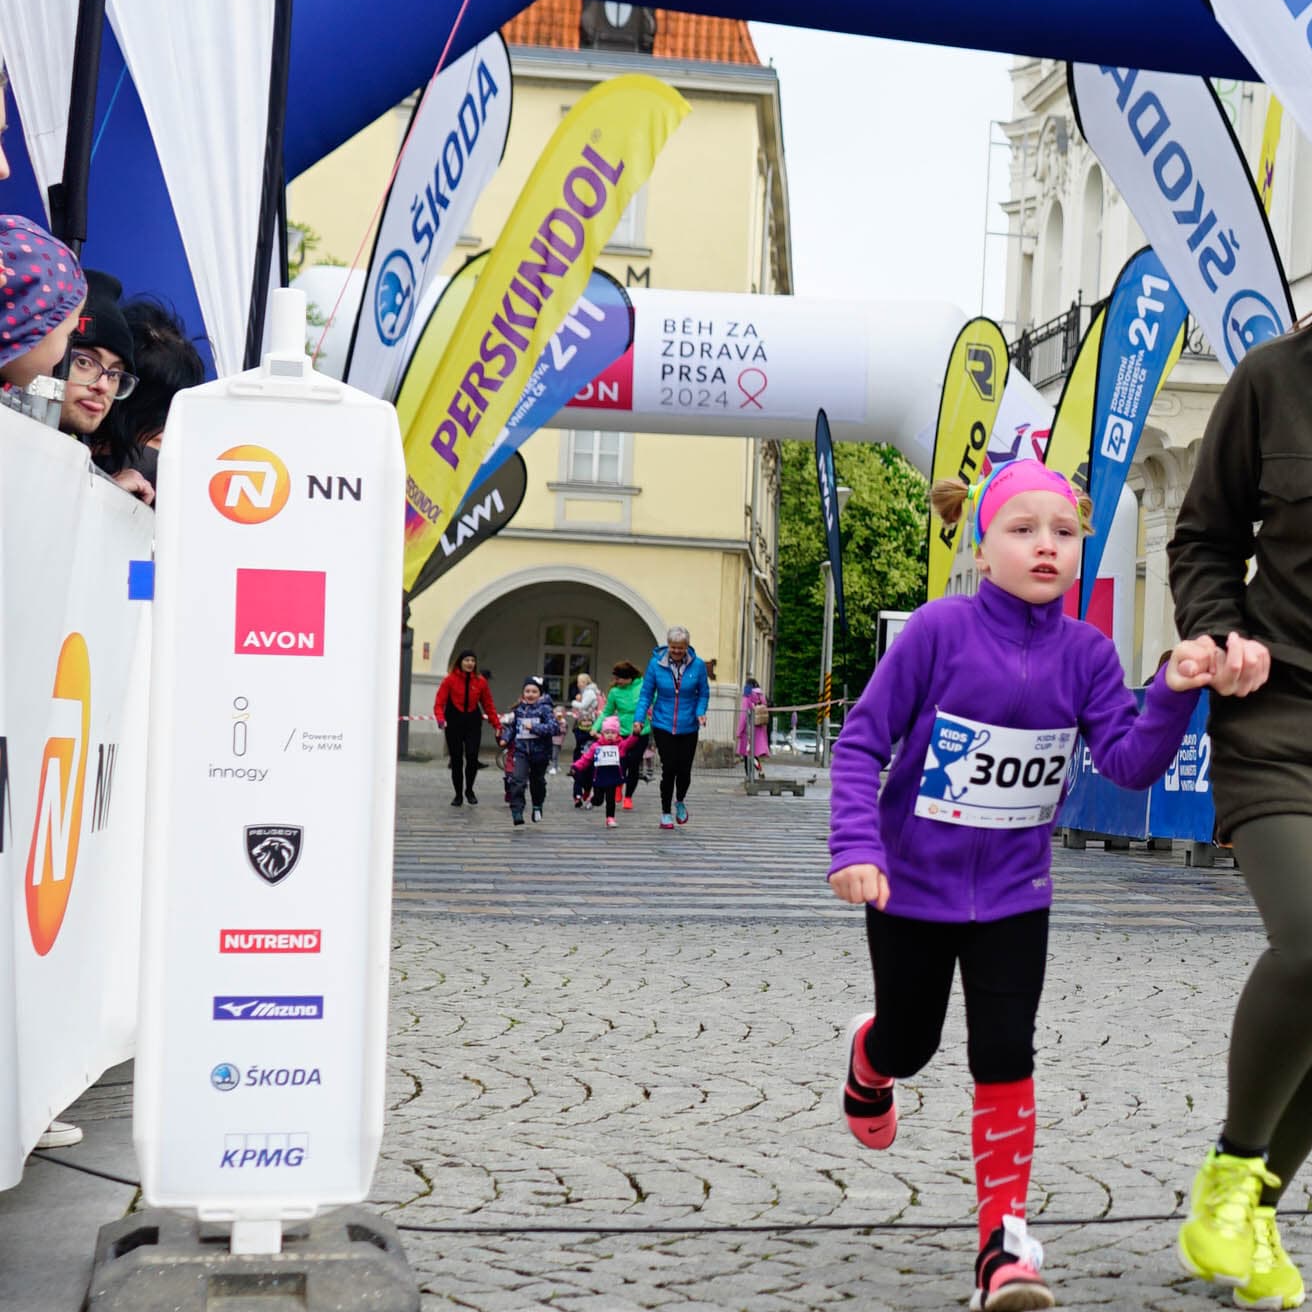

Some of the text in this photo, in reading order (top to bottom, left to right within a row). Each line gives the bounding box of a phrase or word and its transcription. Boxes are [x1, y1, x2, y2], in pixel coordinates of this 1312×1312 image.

[410, 57, 499, 264] ŠKODA
[430, 144, 625, 471] PERSKINDOL
[1128, 274, 1170, 352] 211
[726, 321, 758, 338] ZA
[661, 339, 768, 362] ZDRAVÁ
[661, 363, 727, 385] PRSA
[573, 381, 620, 403] ON
[660, 387, 729, 408] 2024
[307, 474, 362, 502] NN
[243, 631, 315, 649] AVON
[302, 731, 344, 741] Powered
[939, 727, 969, 743] KIDS
[317, 743, 343, 752] MVM
[937, 740, 964, 753] CUP
[208, 763, 269, 783] innogy
[969, 752, 1067, 789] 3002
[248, 828, 299, 837] PEUGEOT
[224, 933, 318, 950] NUTREND
[244, 1065, 322, 1088] ŠKODA
[220, 1146, 305, 1169] KPMG
